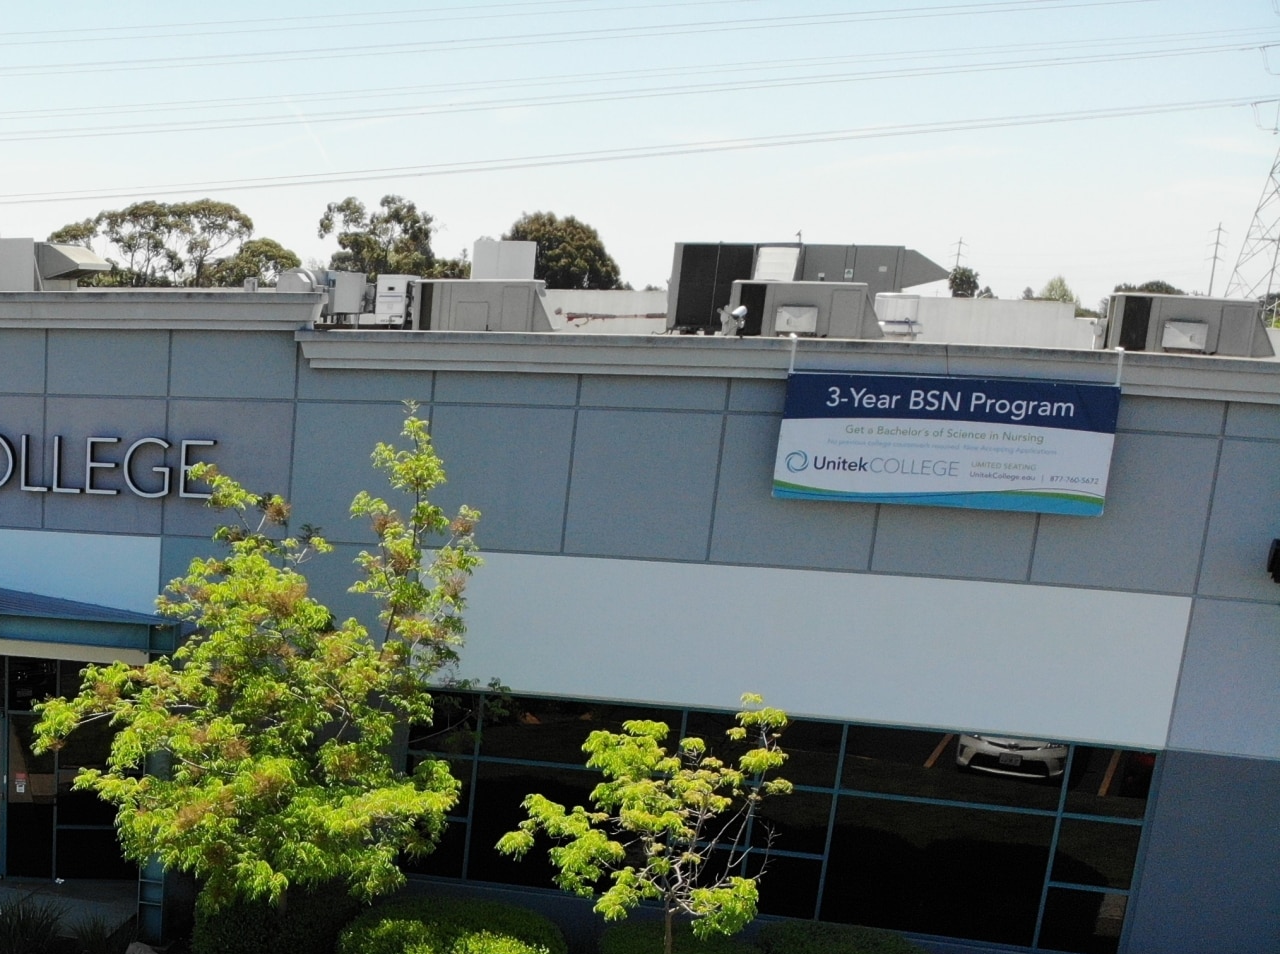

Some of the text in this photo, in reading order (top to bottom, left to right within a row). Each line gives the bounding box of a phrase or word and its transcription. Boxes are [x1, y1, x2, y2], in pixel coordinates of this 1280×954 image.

[825, 386, 1075, 421] 3-Year BSN Program
[845, 424, 864, 434] Get
[932, 427, 945, 438] of
[946, 428, 987, 440] Science
[989, 430, 999, 440] in
[1001, 431, 1045, 445] Nursing
[971, 461, 1037, 471] LIMITED SEATING
